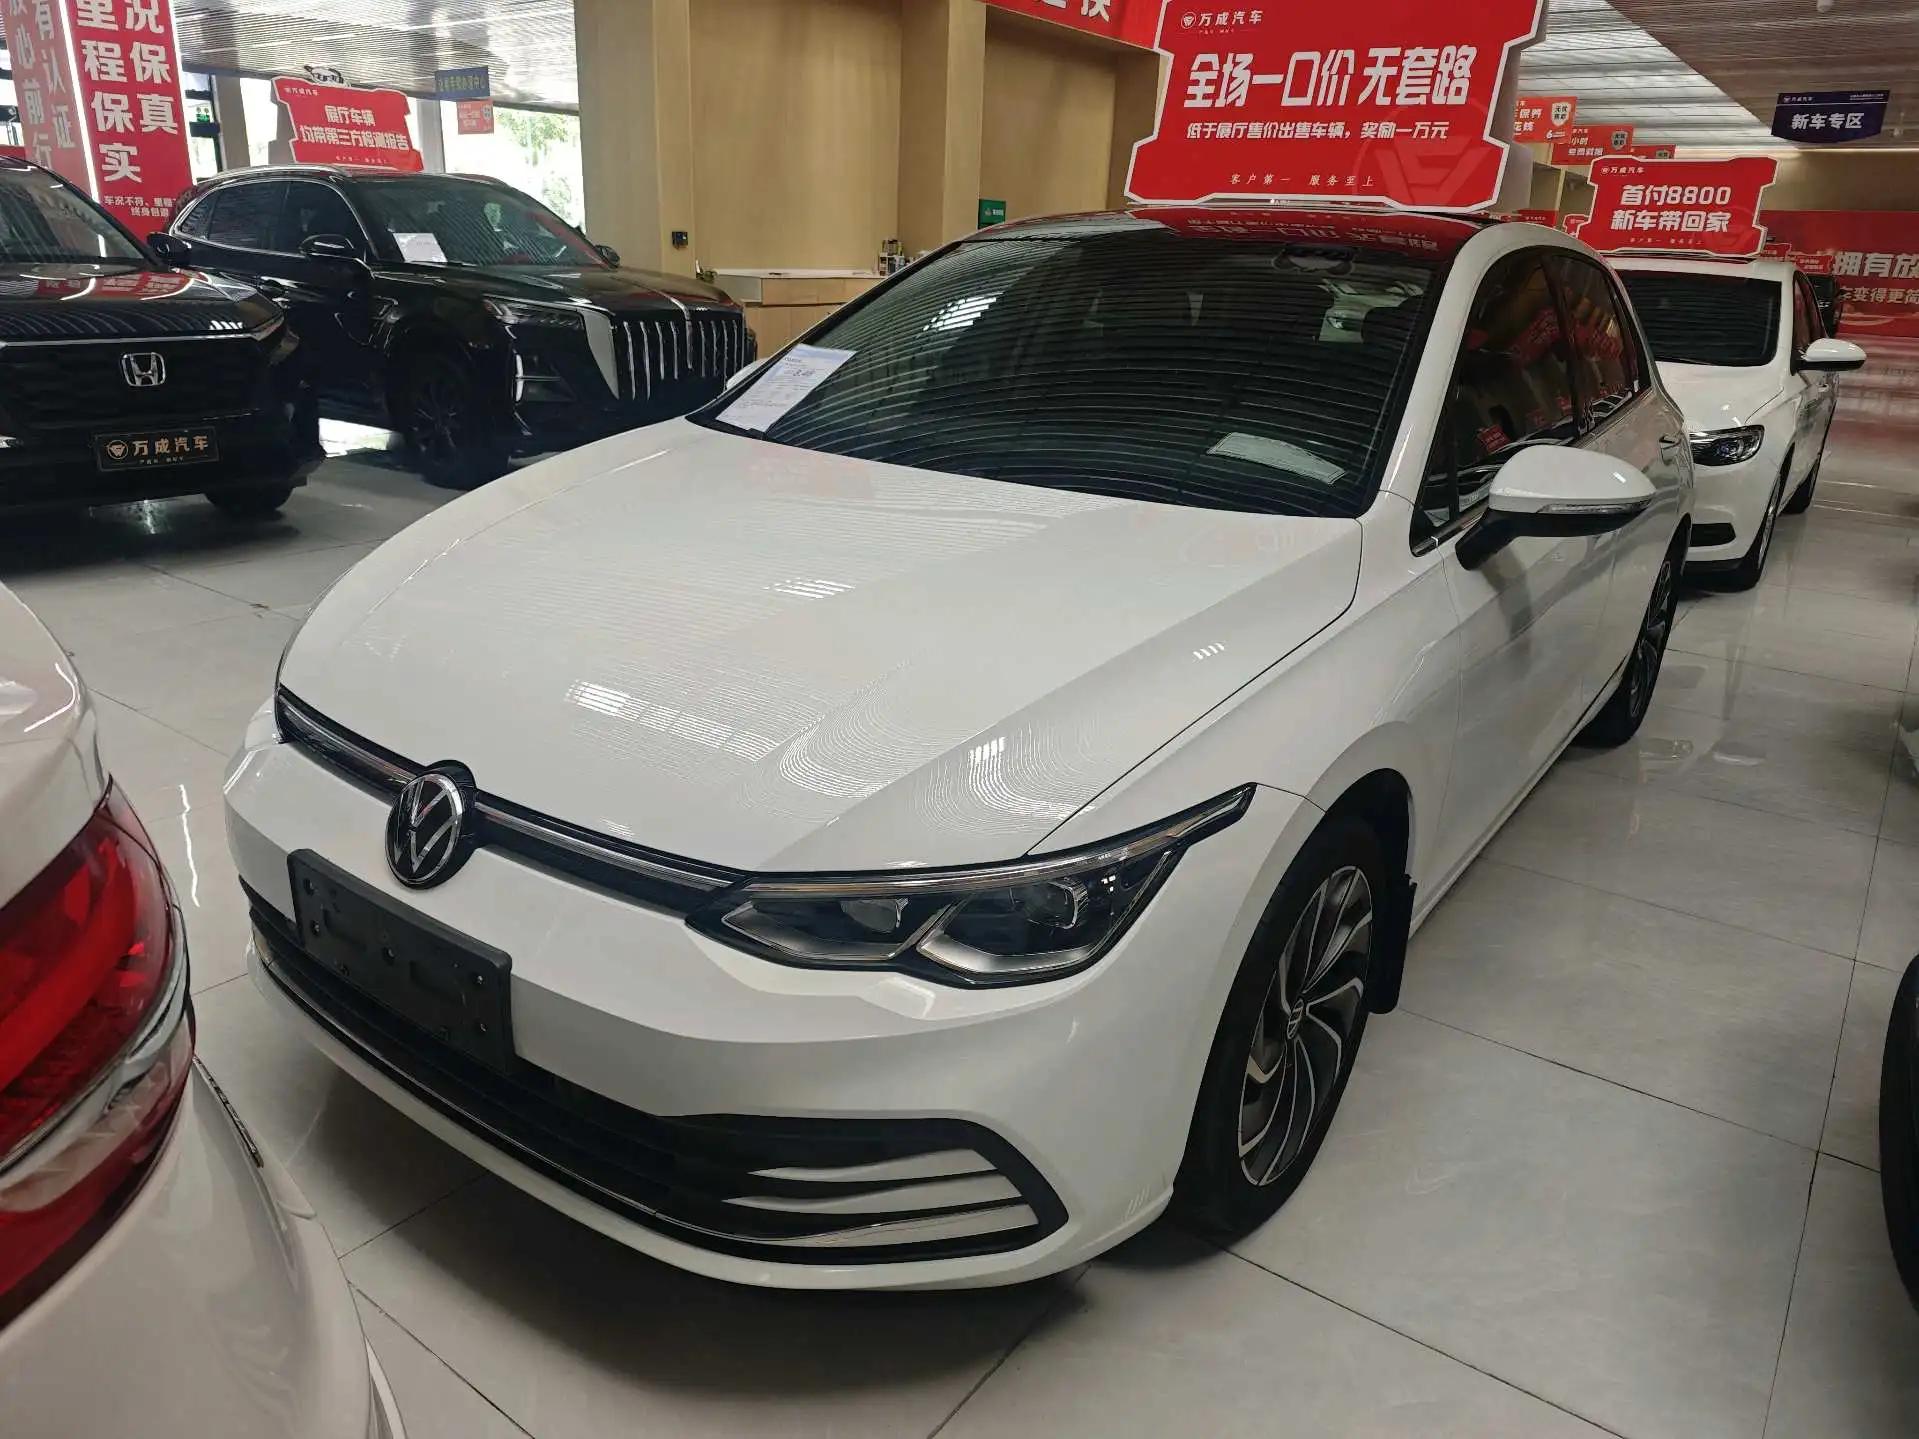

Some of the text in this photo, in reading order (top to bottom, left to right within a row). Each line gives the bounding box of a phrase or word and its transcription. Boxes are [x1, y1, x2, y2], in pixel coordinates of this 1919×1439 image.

[1199, 10, 1263, 27] 万成汽车
[1183, 44, 1478, 108] 全场一口价 无套路
[324, 105, 375, 127] 展厅车辆
[1791, 112, 1865, 130] 新车专区
[1228, 173, 1376, 187] 客户第一 服务至上
[1620, 184, 1732, 206] 首付8800
[1610, 209, 1732, 233] 新车带回家
[132, 435, 208, 456] 万成汽车
